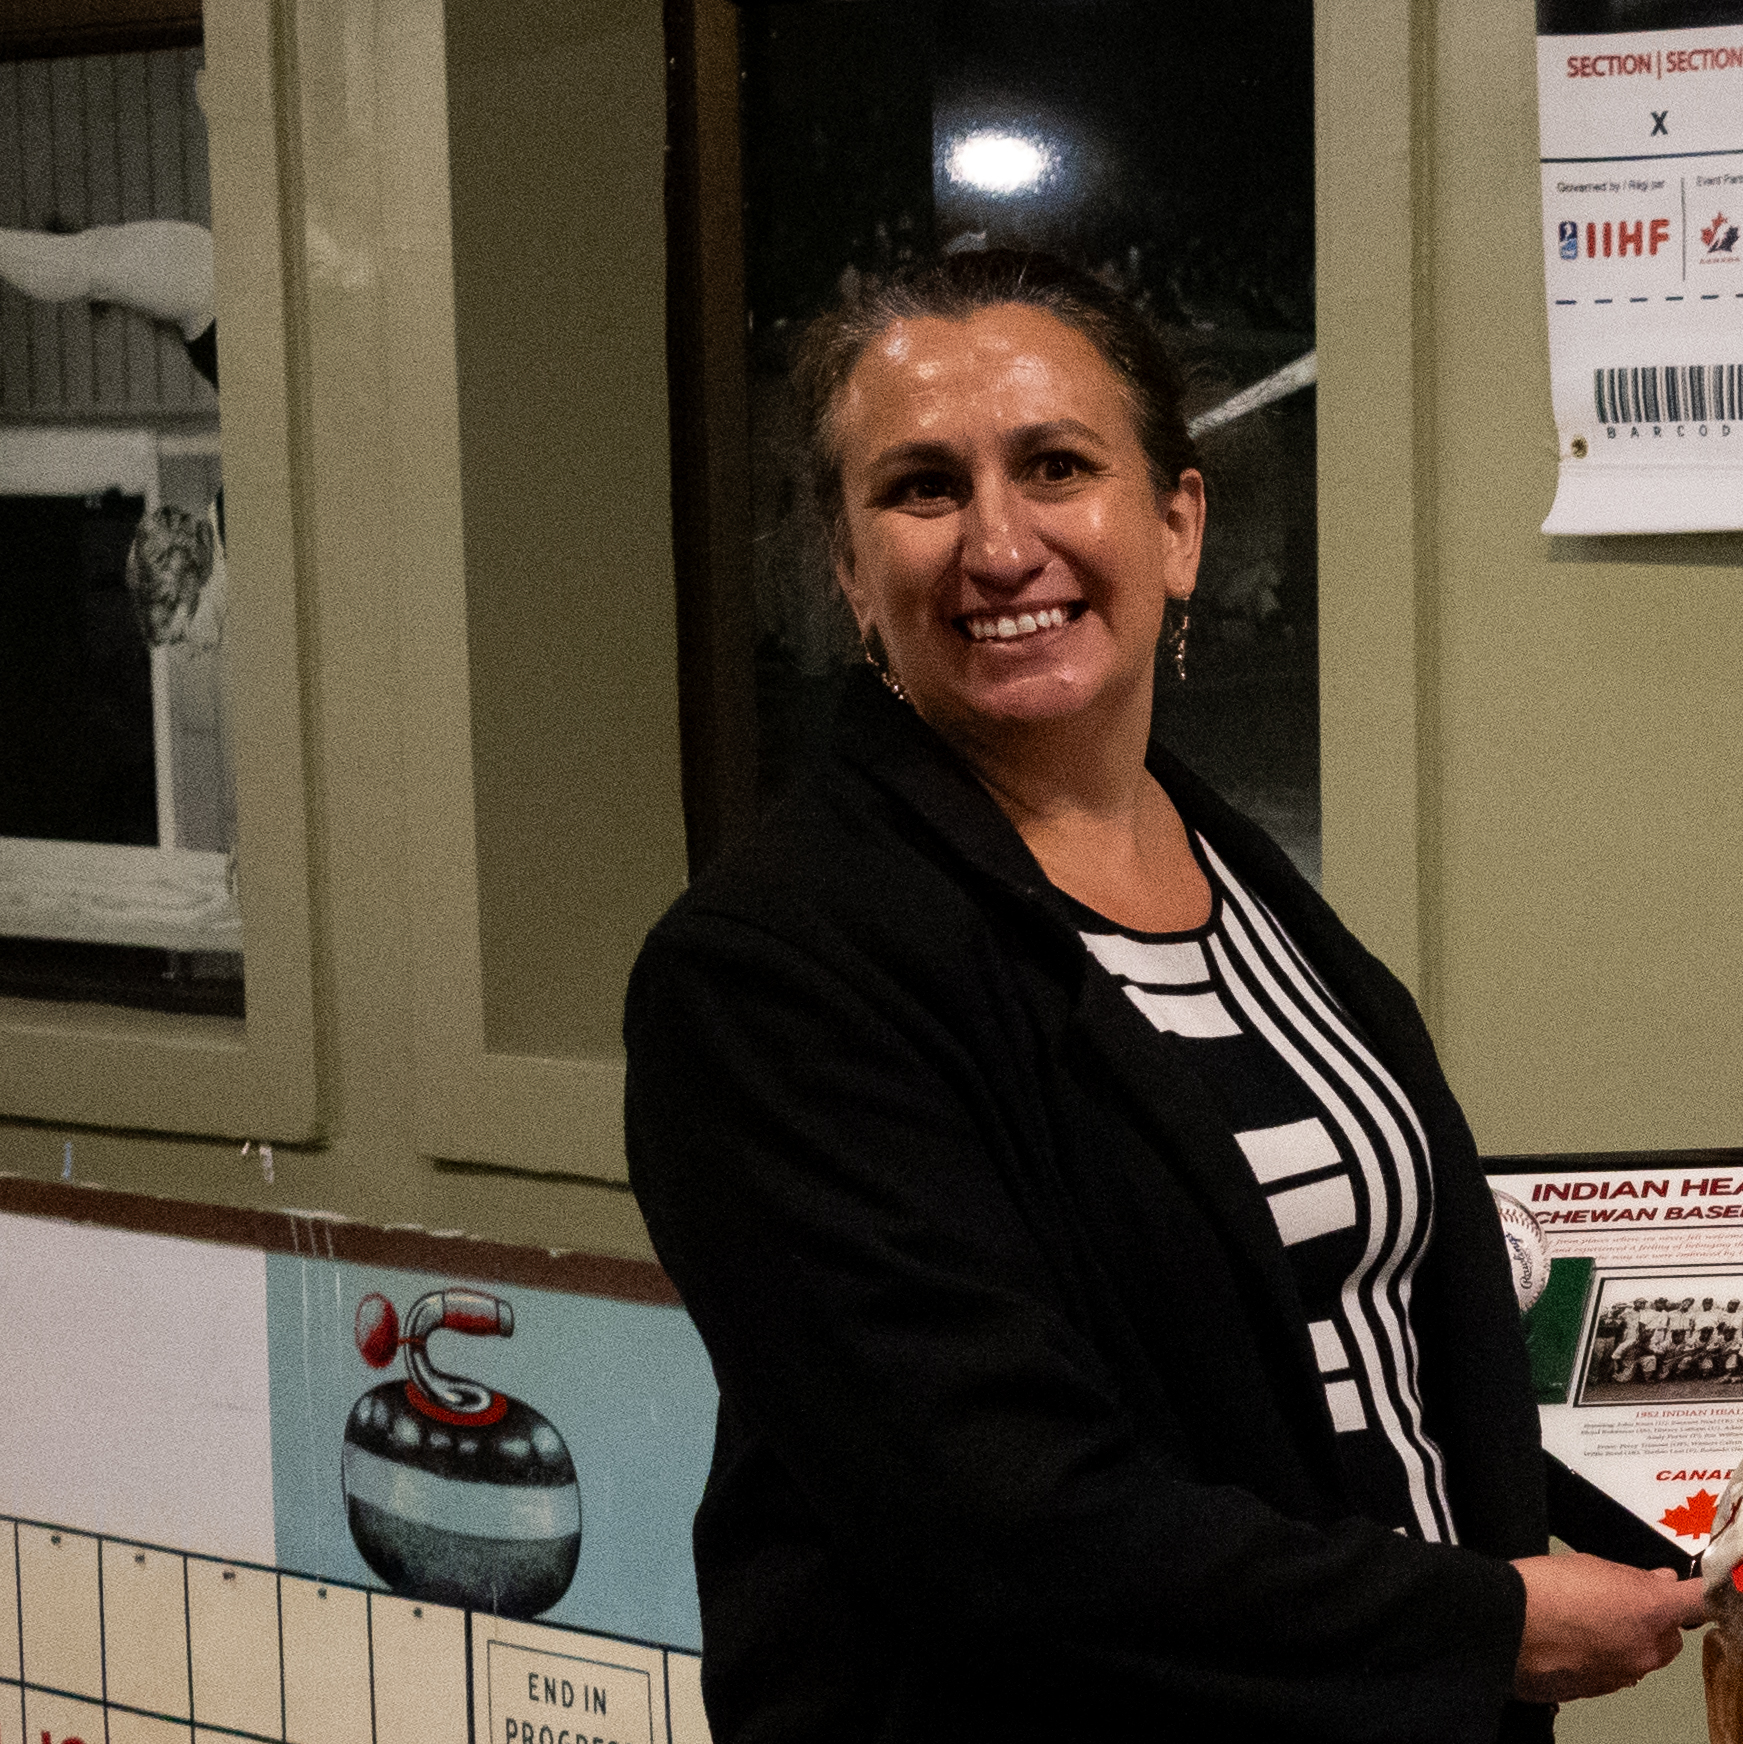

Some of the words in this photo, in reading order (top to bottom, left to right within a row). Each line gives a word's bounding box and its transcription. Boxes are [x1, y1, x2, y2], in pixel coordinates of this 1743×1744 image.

[1567, 53, 1652, 78] SECTION
[1666, 46, 1743, 73] SECTION
[1651, 111, 1668, 136] X
[1586, 220, 1670, 259] IIHF
[1531, 1180, 1669, 1202] INDIAN
[527, 1672, 575, 1708] END
[583, 1686, 608, 1716] IN
